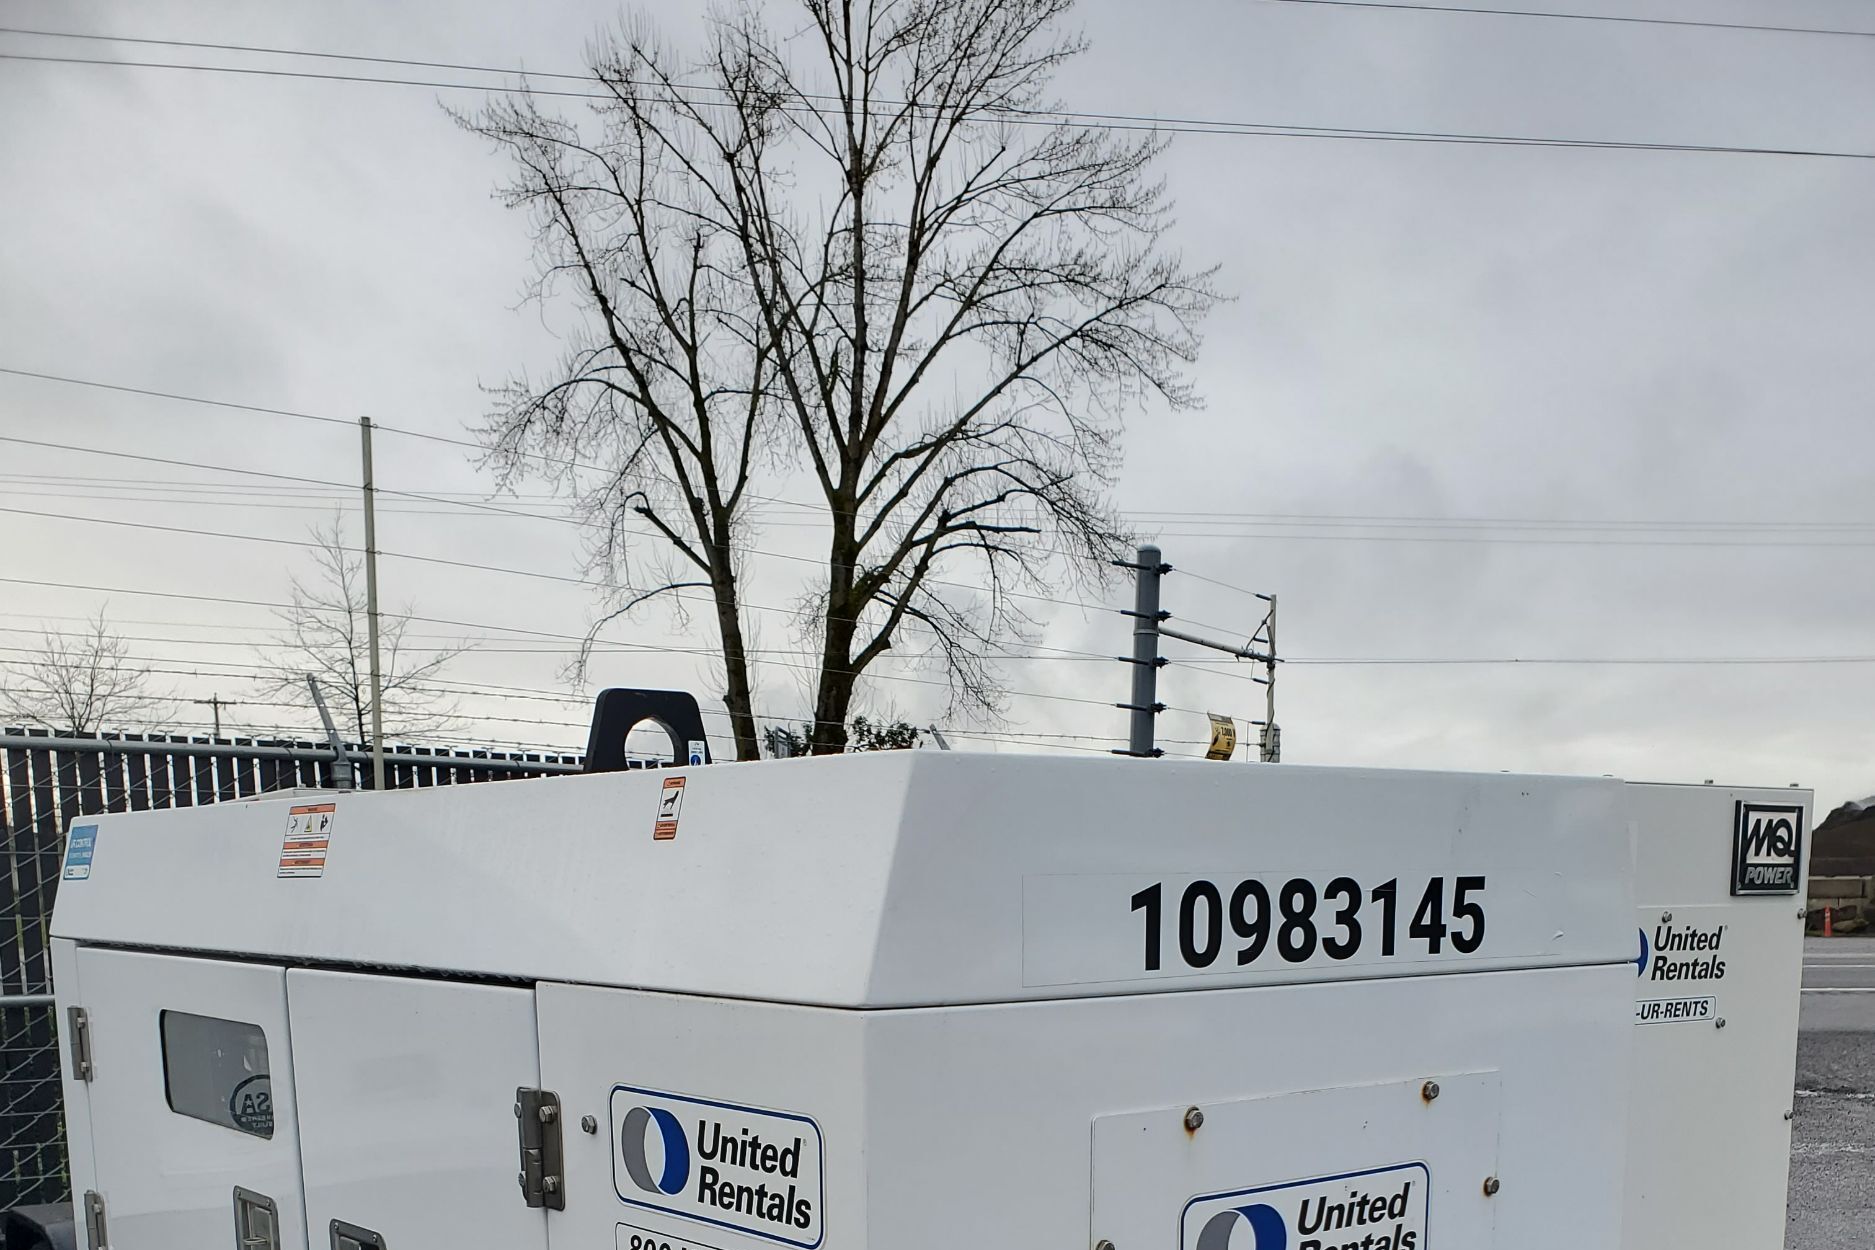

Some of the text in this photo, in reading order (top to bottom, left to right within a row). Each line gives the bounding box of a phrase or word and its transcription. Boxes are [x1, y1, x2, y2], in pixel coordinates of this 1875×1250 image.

[1746, 818, 1794, 857] MQ
[1745, 866, 1794, 886] POWER
[1131, 875, 1486, 971] 10983145
[1654, 925, 1723, 951] United
[1651, 954, 1726, 981] Rentals
[1636, 1000, 1709, 1020] -UR-RENTS
[697, 1119, 801, 1179] United
[697, 1165, 812, 1229] Rentals
[1297, 1181, 1411, 1236] United
